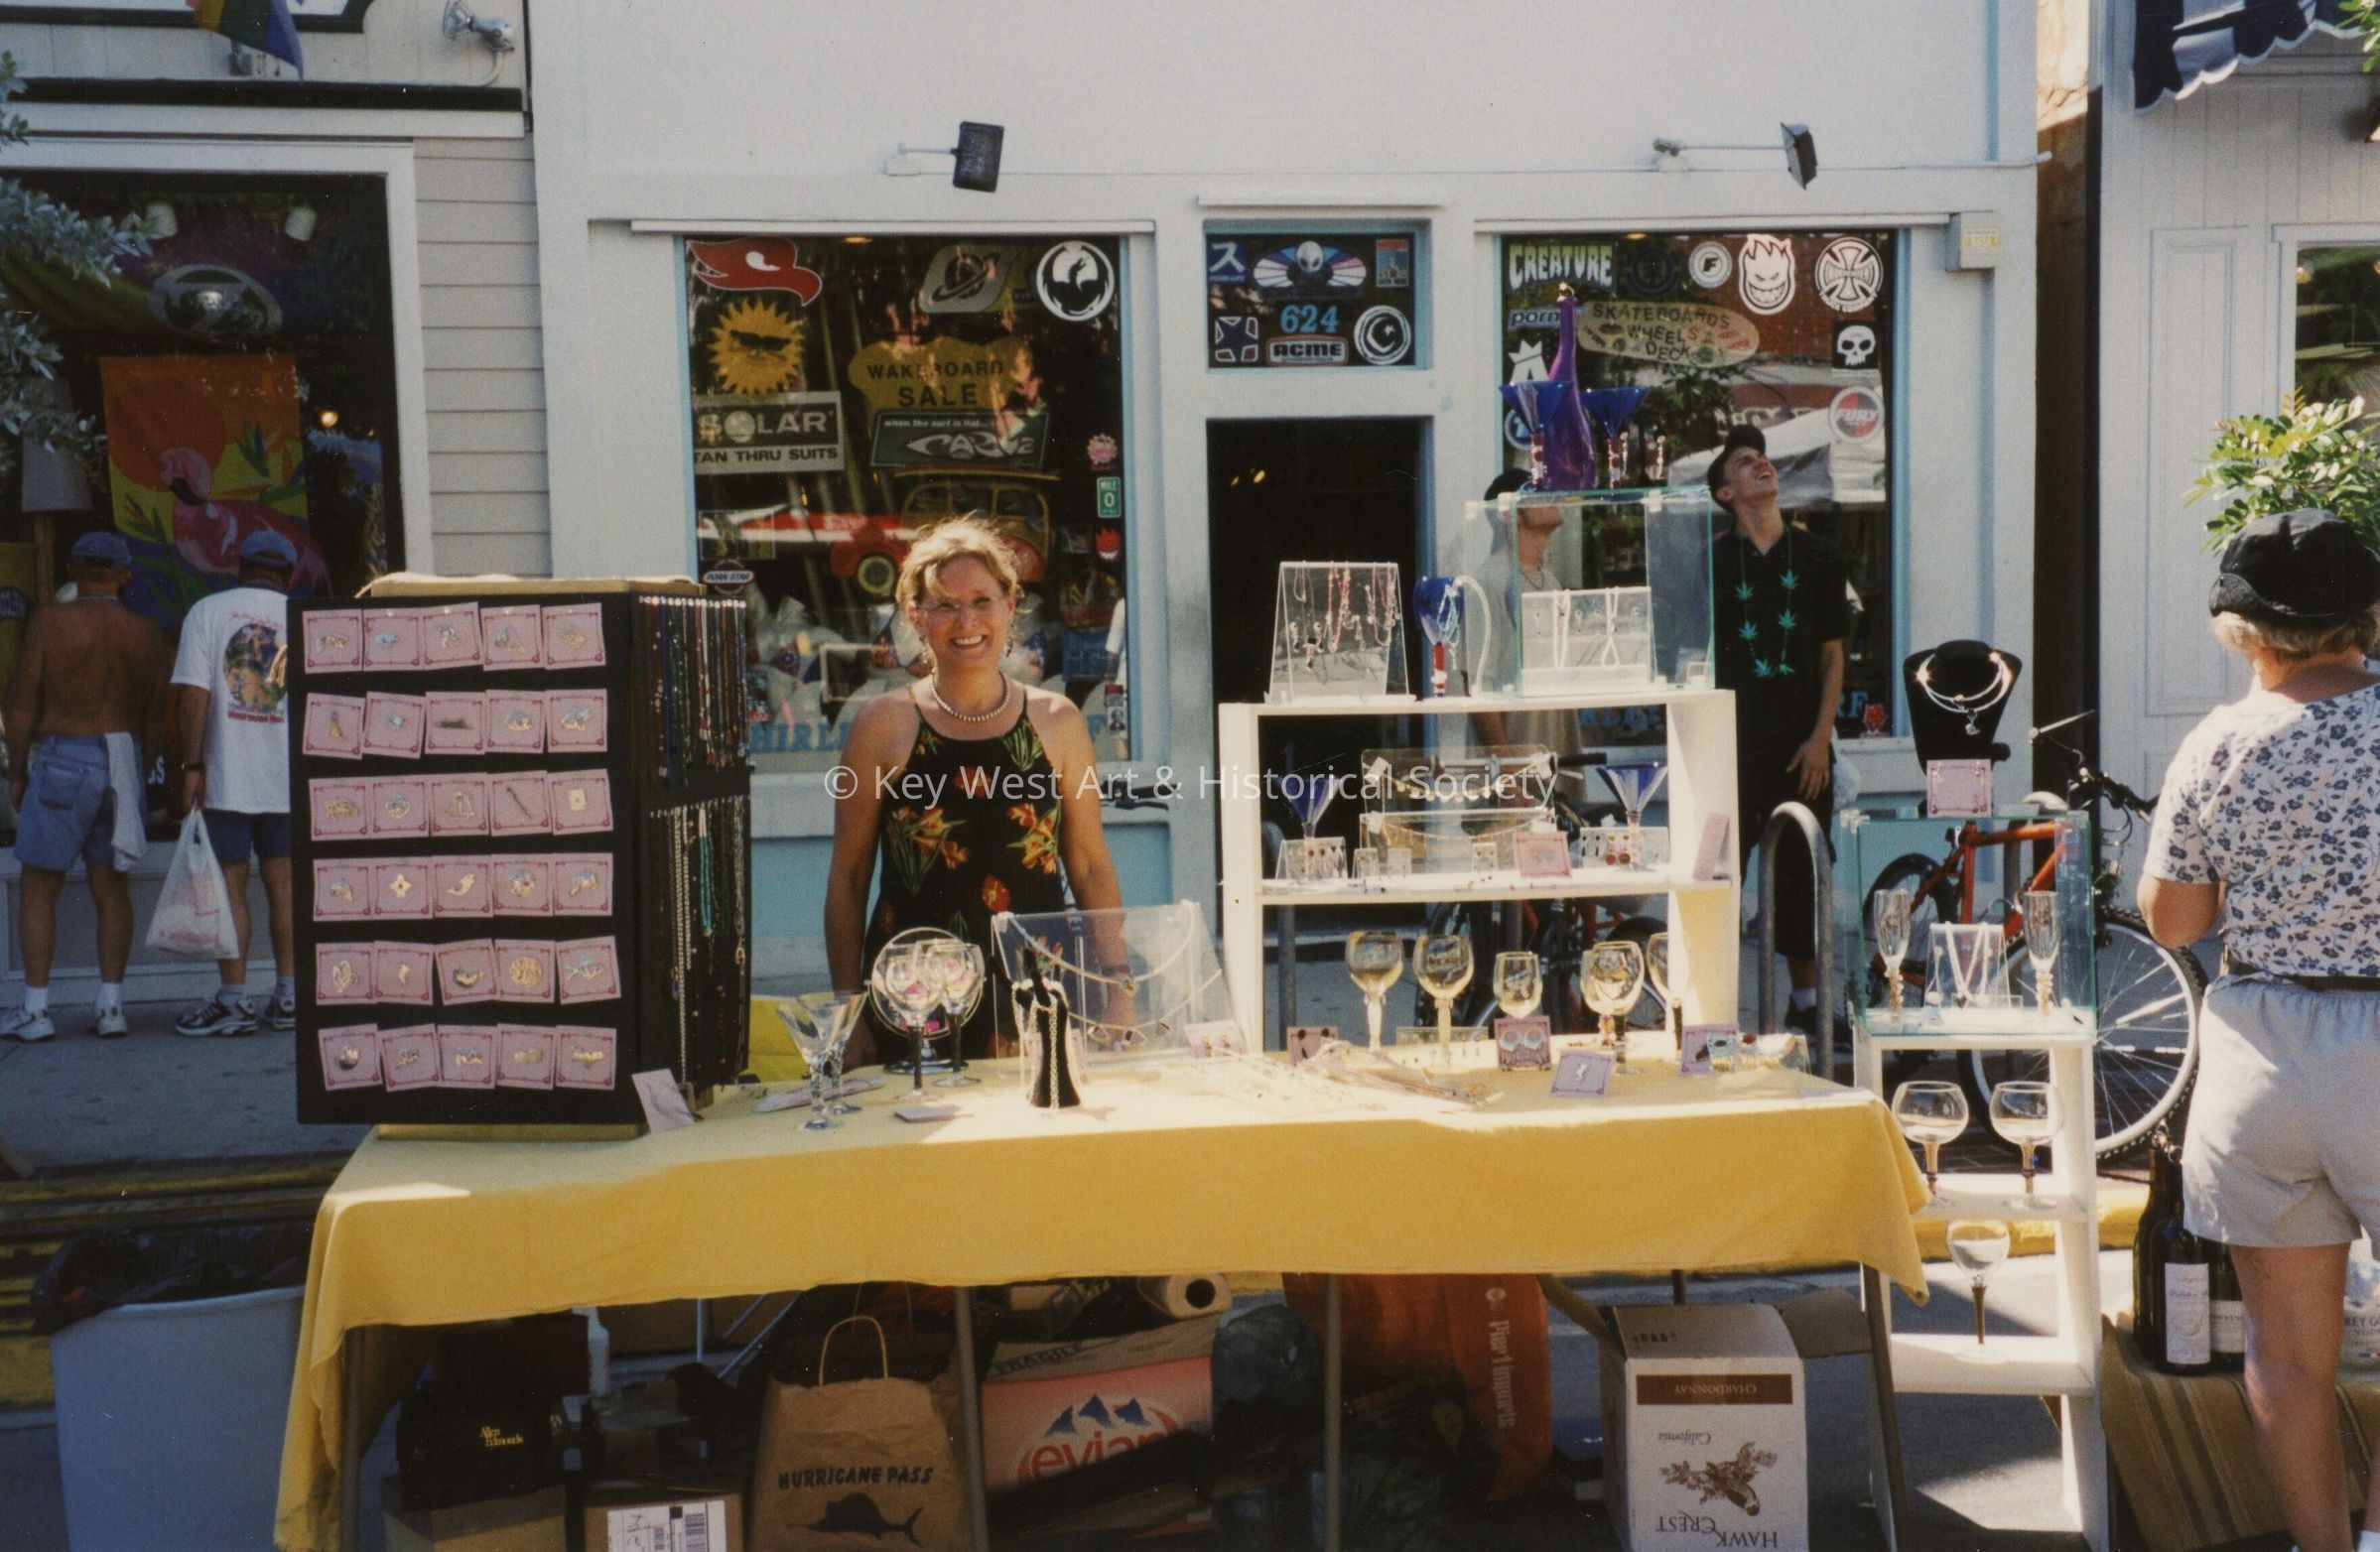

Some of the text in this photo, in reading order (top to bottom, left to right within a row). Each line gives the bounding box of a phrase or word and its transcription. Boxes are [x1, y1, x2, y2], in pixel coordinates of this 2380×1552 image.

[1509, 244, 1613, 291] CREATURE
[1281, 305, 1337, 333] 624
[1593, 303, 1730, 329] SKATEBOARDS
[1628, 324, 1700, 344] WHEELS
[1273, 343, 1342, 356] ACME
[898, 383, 977, 407] SALE
[734, 450, 781, 461] THRU
[789, 448, 838, 460] SUITS
[1674, 1384, 1757, 1394] CHARDONNAY
[1658, 1429, 1712, 1446] California
[1031, 1430, 1166, 1478] evia
[778, 1466, 935, 1489] HURRICANE PASS
[1655, 1510, 1716, 1534] CREST
[1715, 1528, 1778, 1548] HAWK
